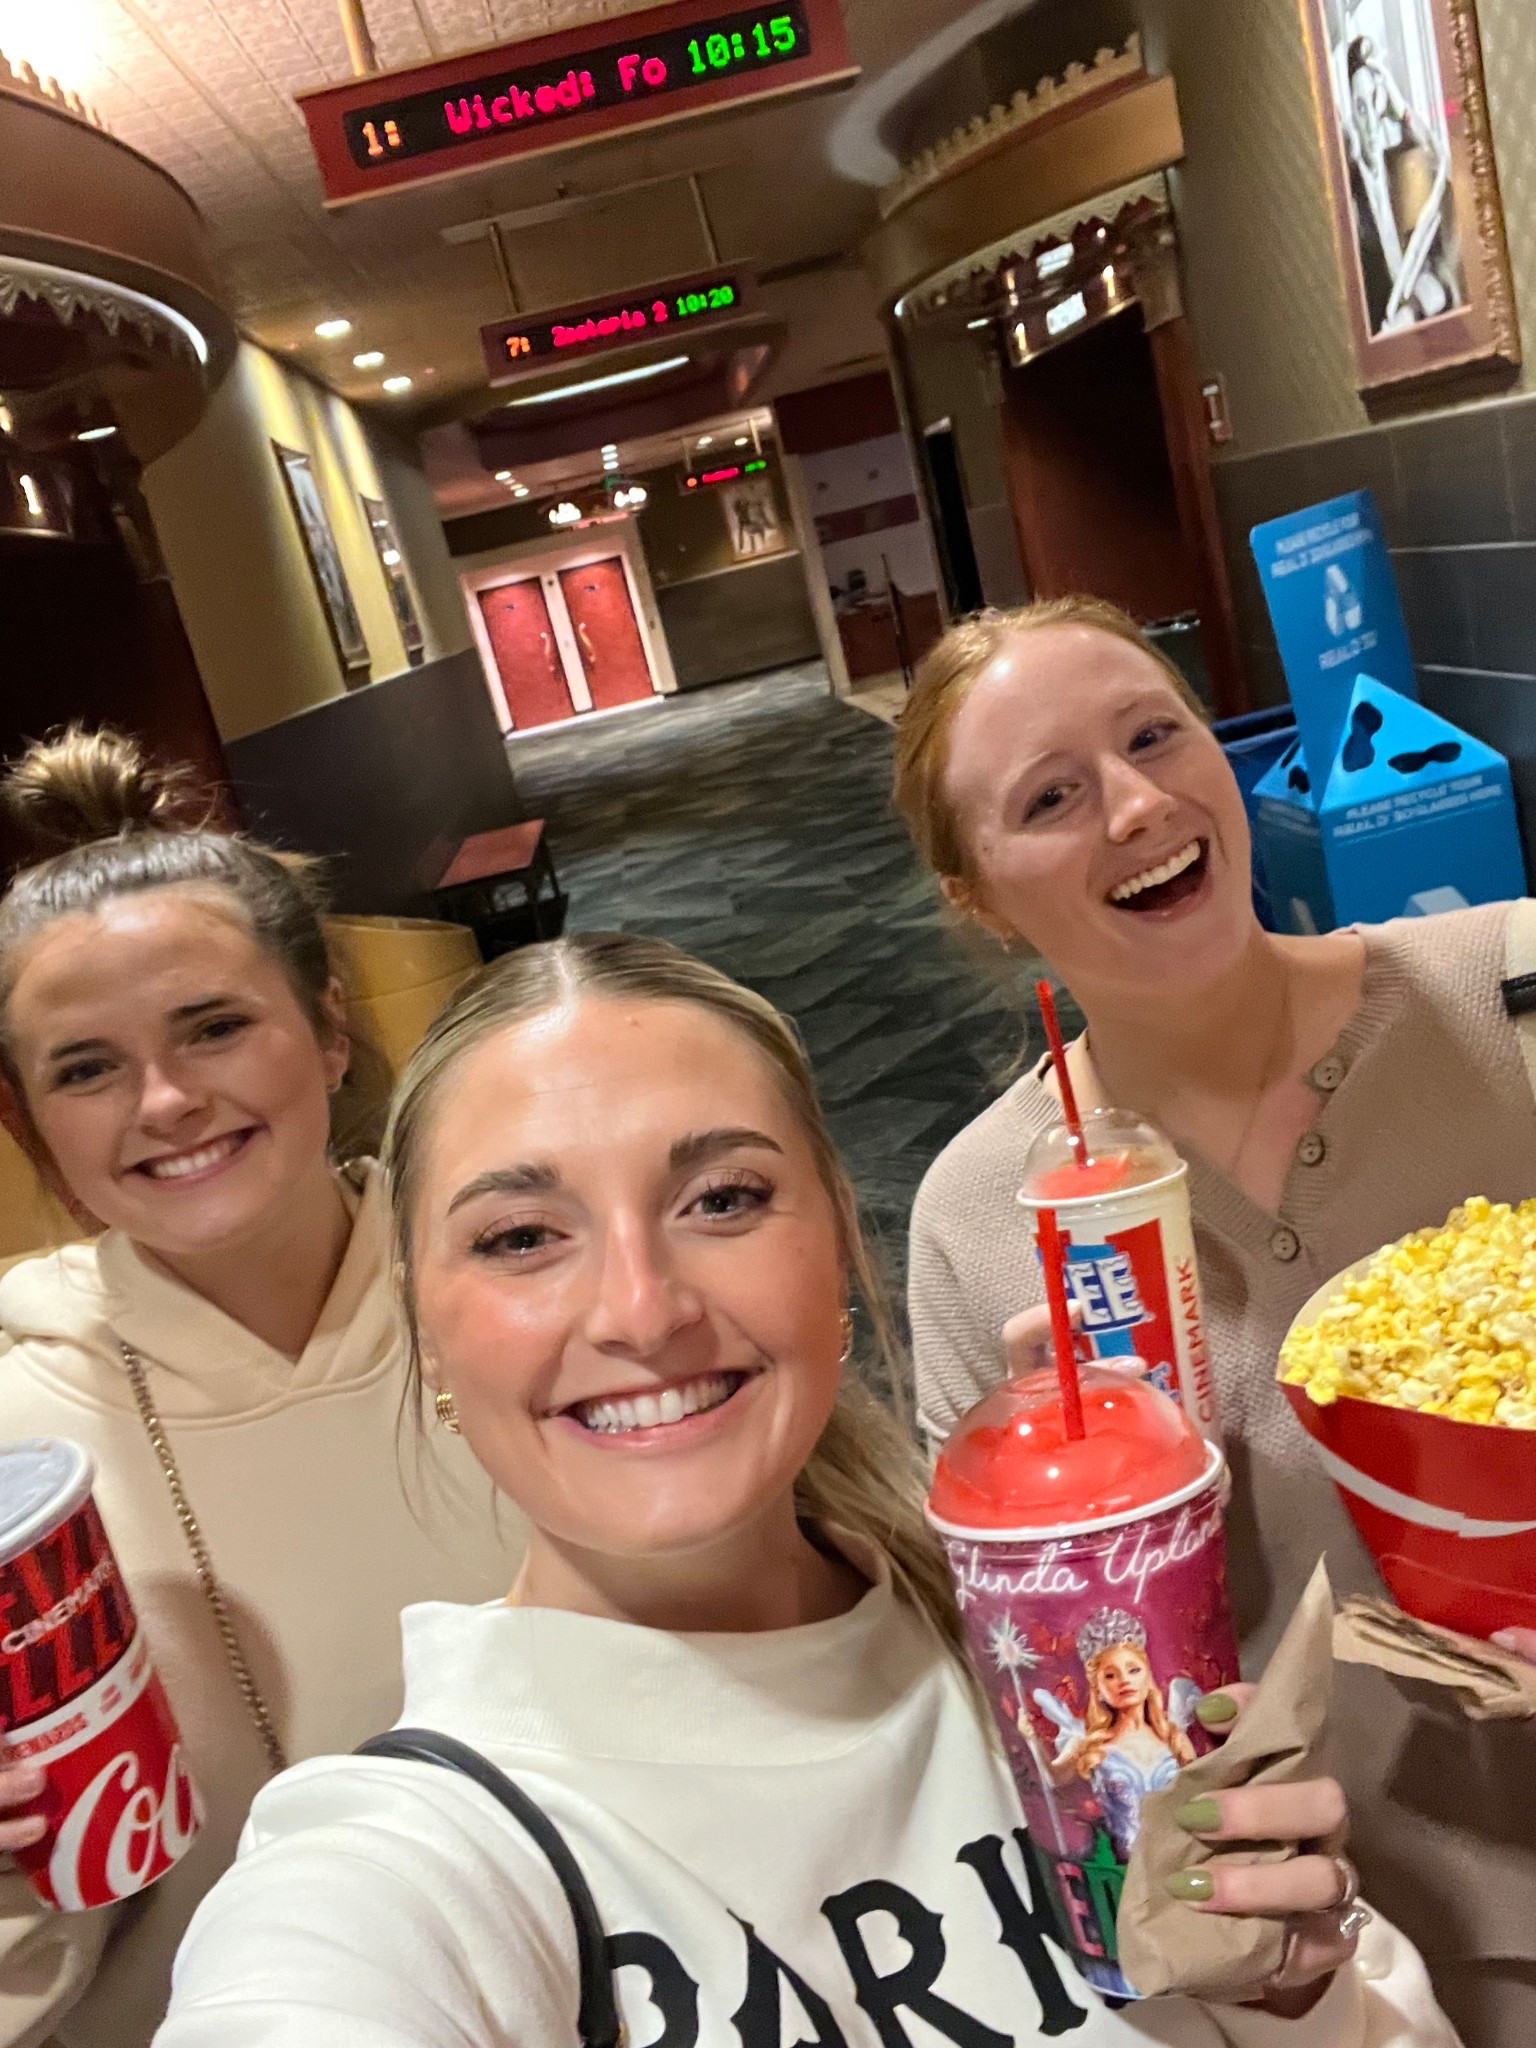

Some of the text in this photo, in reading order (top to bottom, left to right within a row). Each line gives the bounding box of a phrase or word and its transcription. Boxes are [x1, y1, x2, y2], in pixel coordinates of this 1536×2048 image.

[362, 15, 797, 157] 1: Wicked: Fo 10:15
[651, 300, 669, 323] 2
[676, 284, 734, 317] 10:20
[1062, 1252, 1154, 1333] EE
[1177, 1255, 1213, 1423] CINEMARK
[947, 1540, 1089, 1611] Glinda
